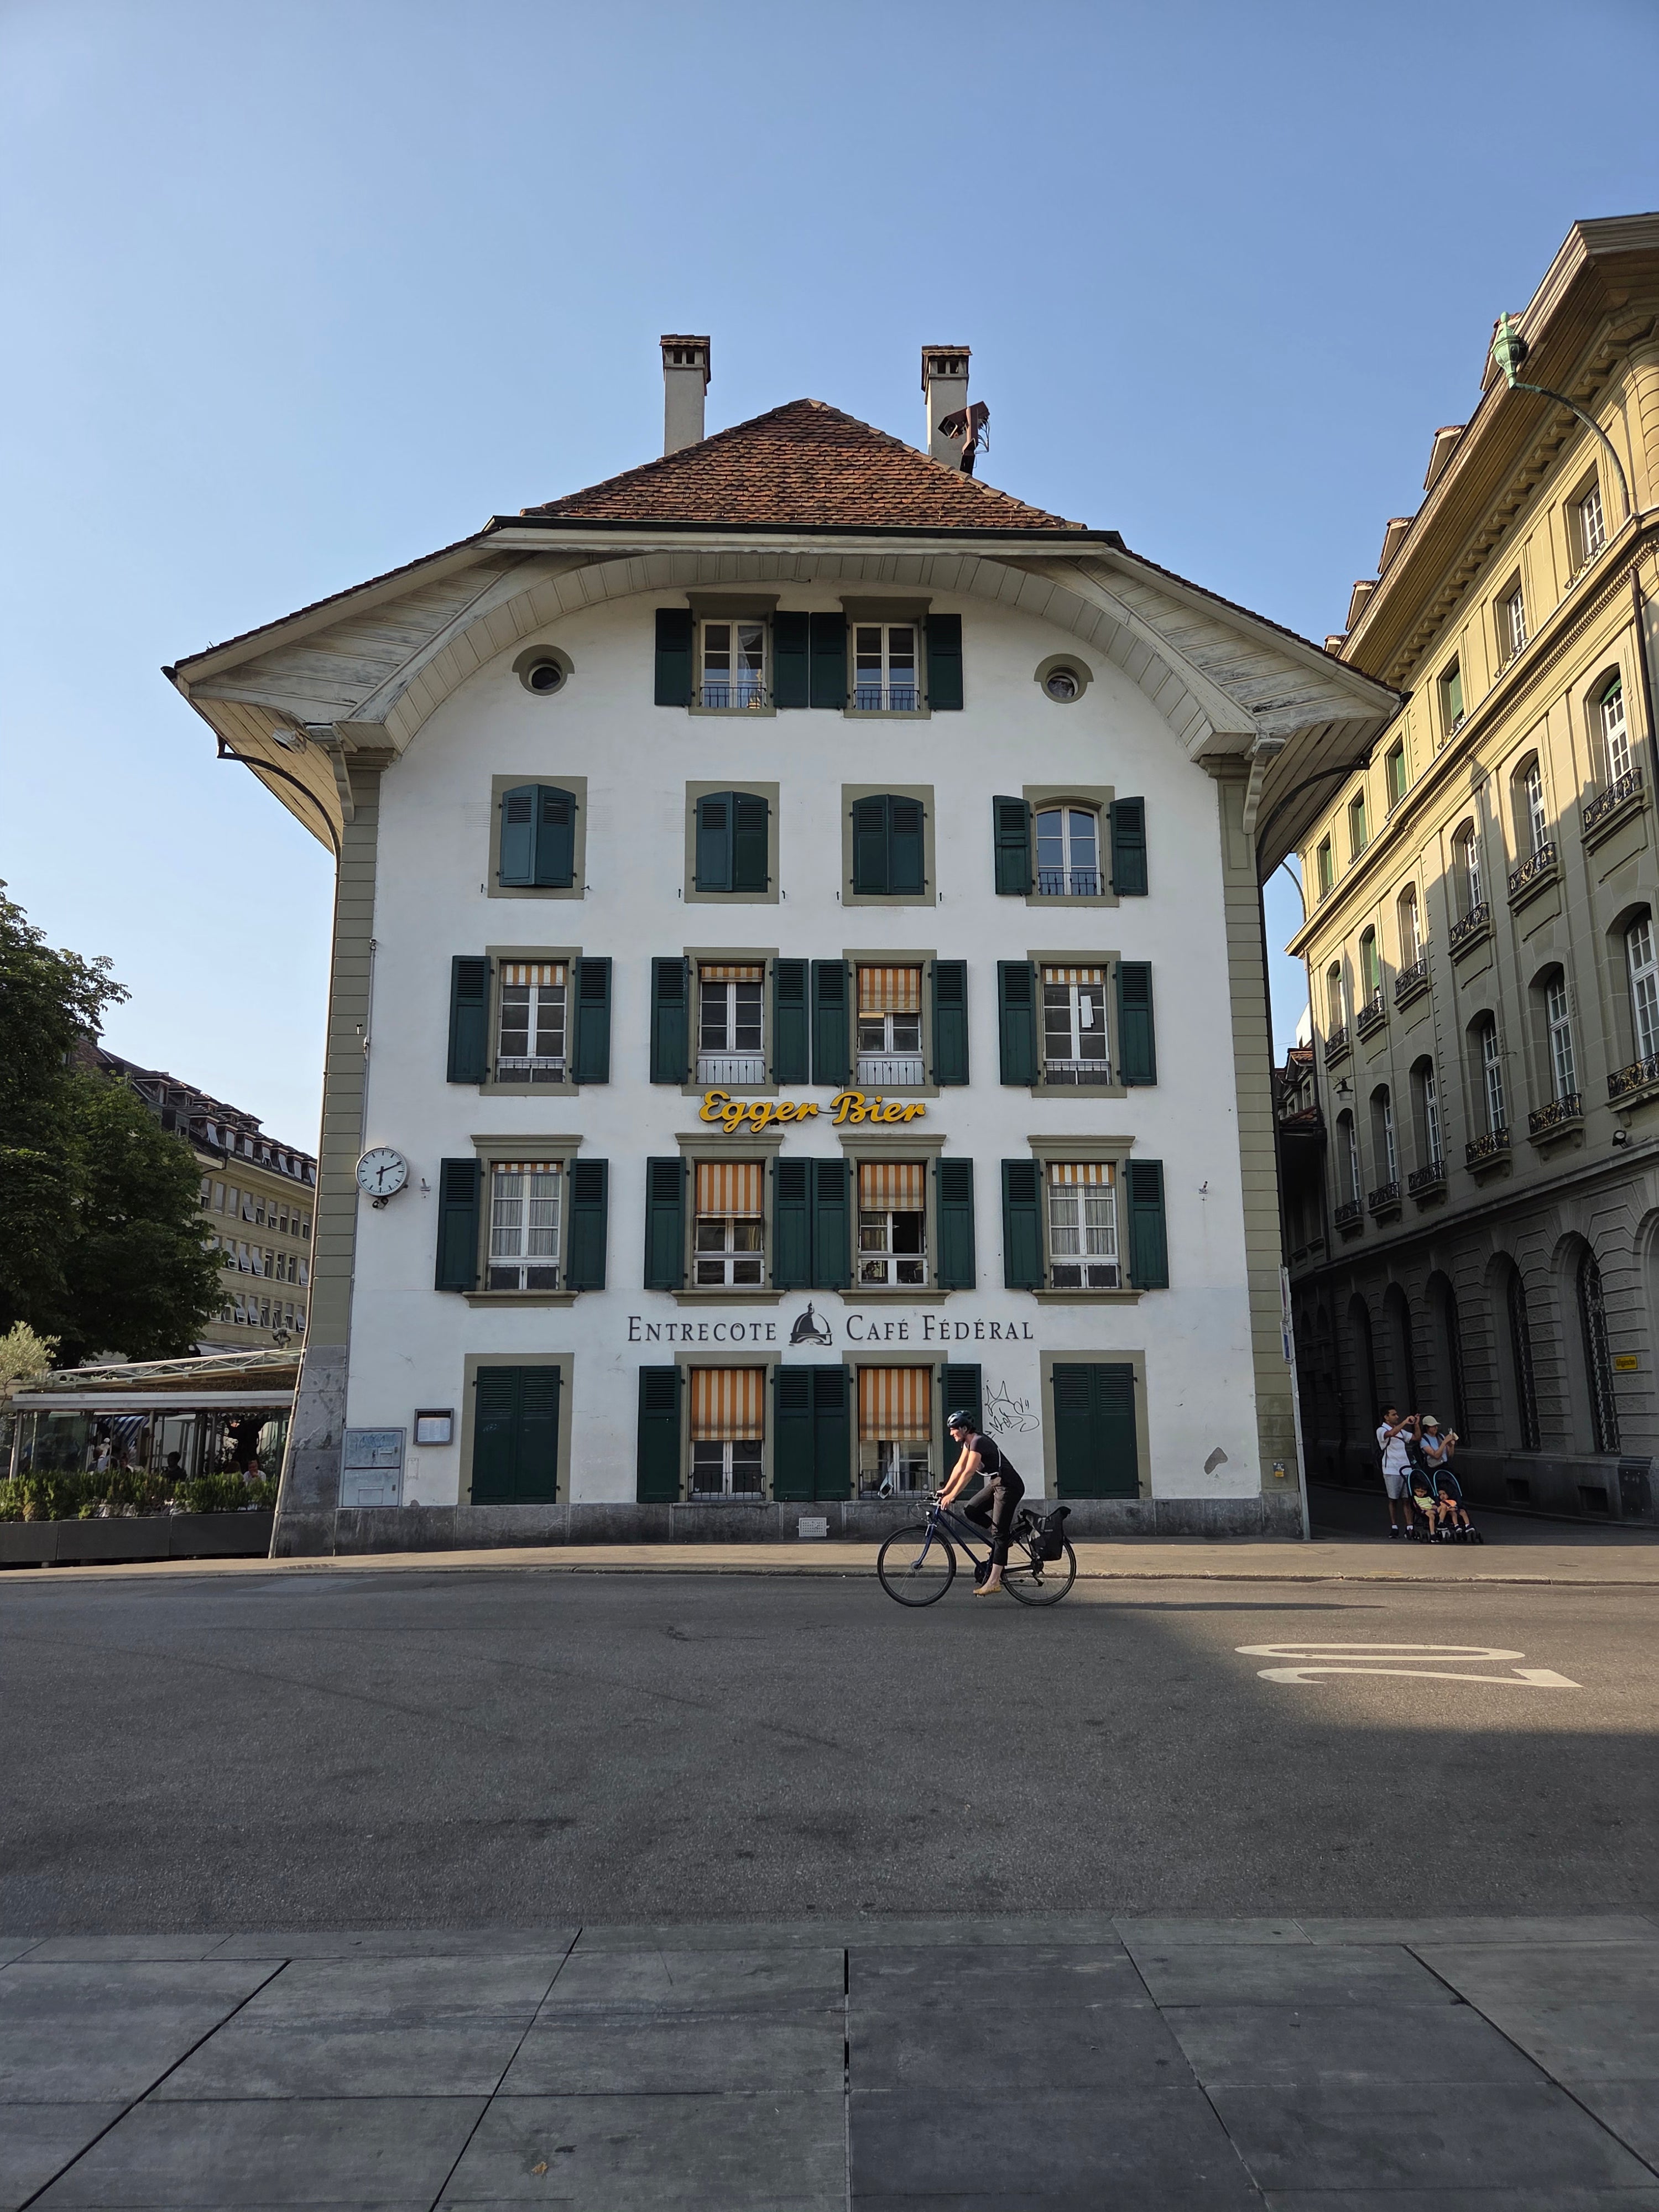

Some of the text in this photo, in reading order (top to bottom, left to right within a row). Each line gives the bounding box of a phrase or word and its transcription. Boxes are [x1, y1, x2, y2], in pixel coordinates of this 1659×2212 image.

[699, 1090, 926, 1134] Egger Bier
[846, 1314, 910, 1340] CAFÉ
[922, 1314, 1034, 1340] FÉDÉRAL
